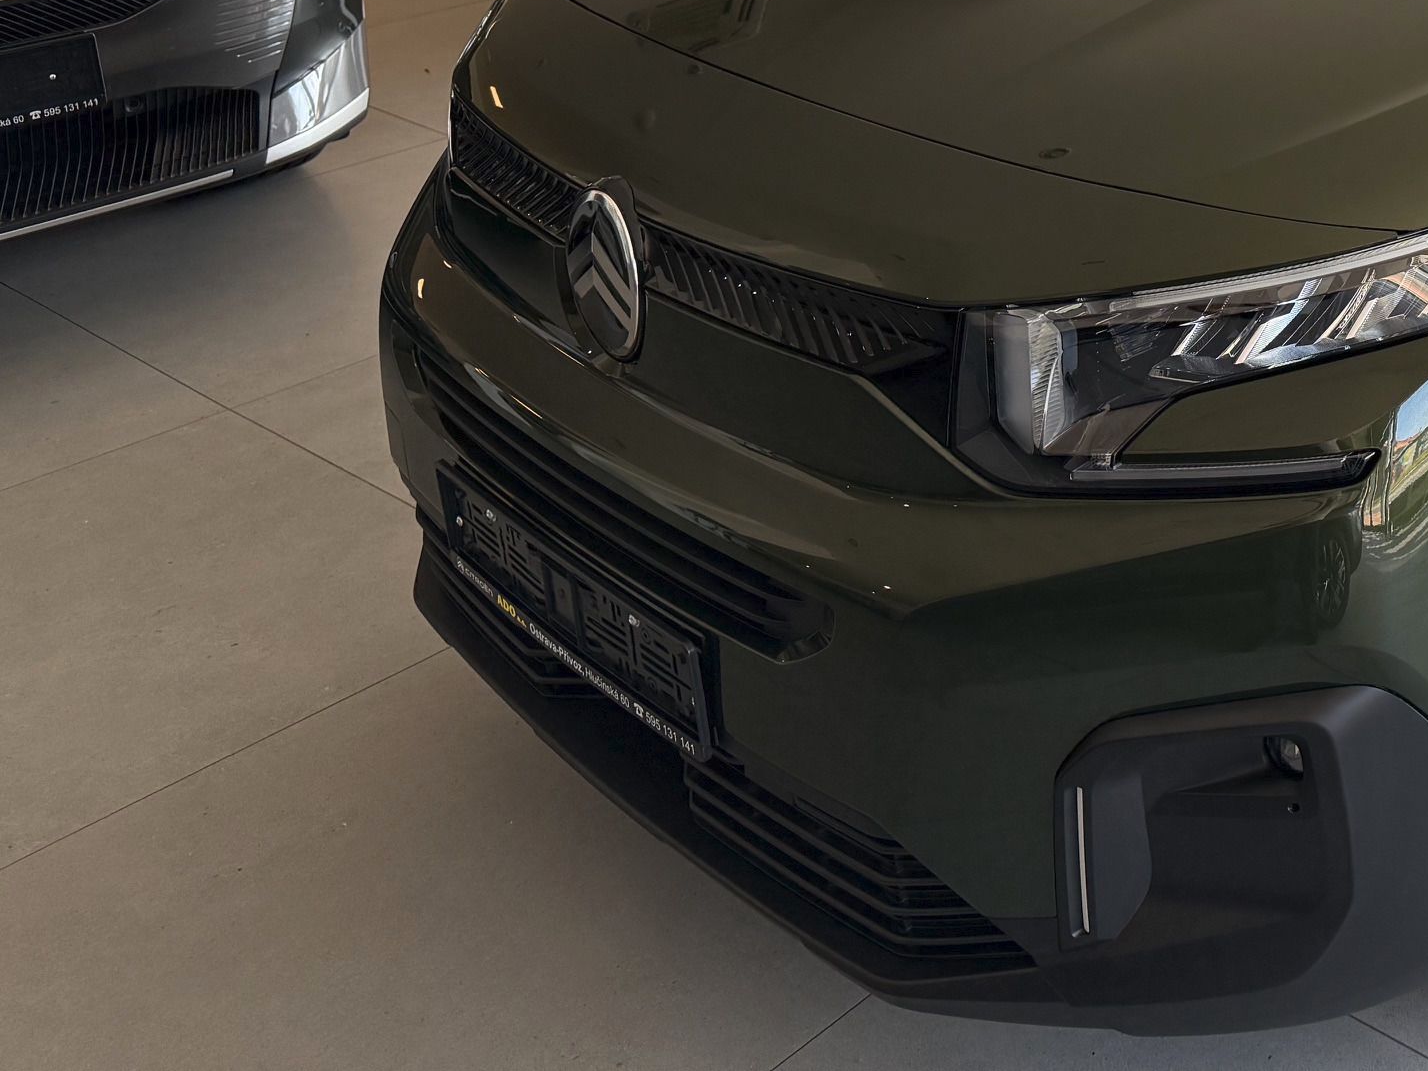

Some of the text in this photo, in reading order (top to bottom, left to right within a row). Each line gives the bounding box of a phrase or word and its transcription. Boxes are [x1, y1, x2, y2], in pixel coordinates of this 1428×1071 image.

[13, 114, 25, 125] 60
[43, 105, 61, 118] 595
[63, 101, 80, 113] 131
[82, 97, 99, 109] 141
[497, 593, 516, 618] ADO
[620, 693, 630, 709] 60
[645, 711, 661, 731] 595
[663, 724, 677, 743] 131
[680, 736, 695, 756] 141
